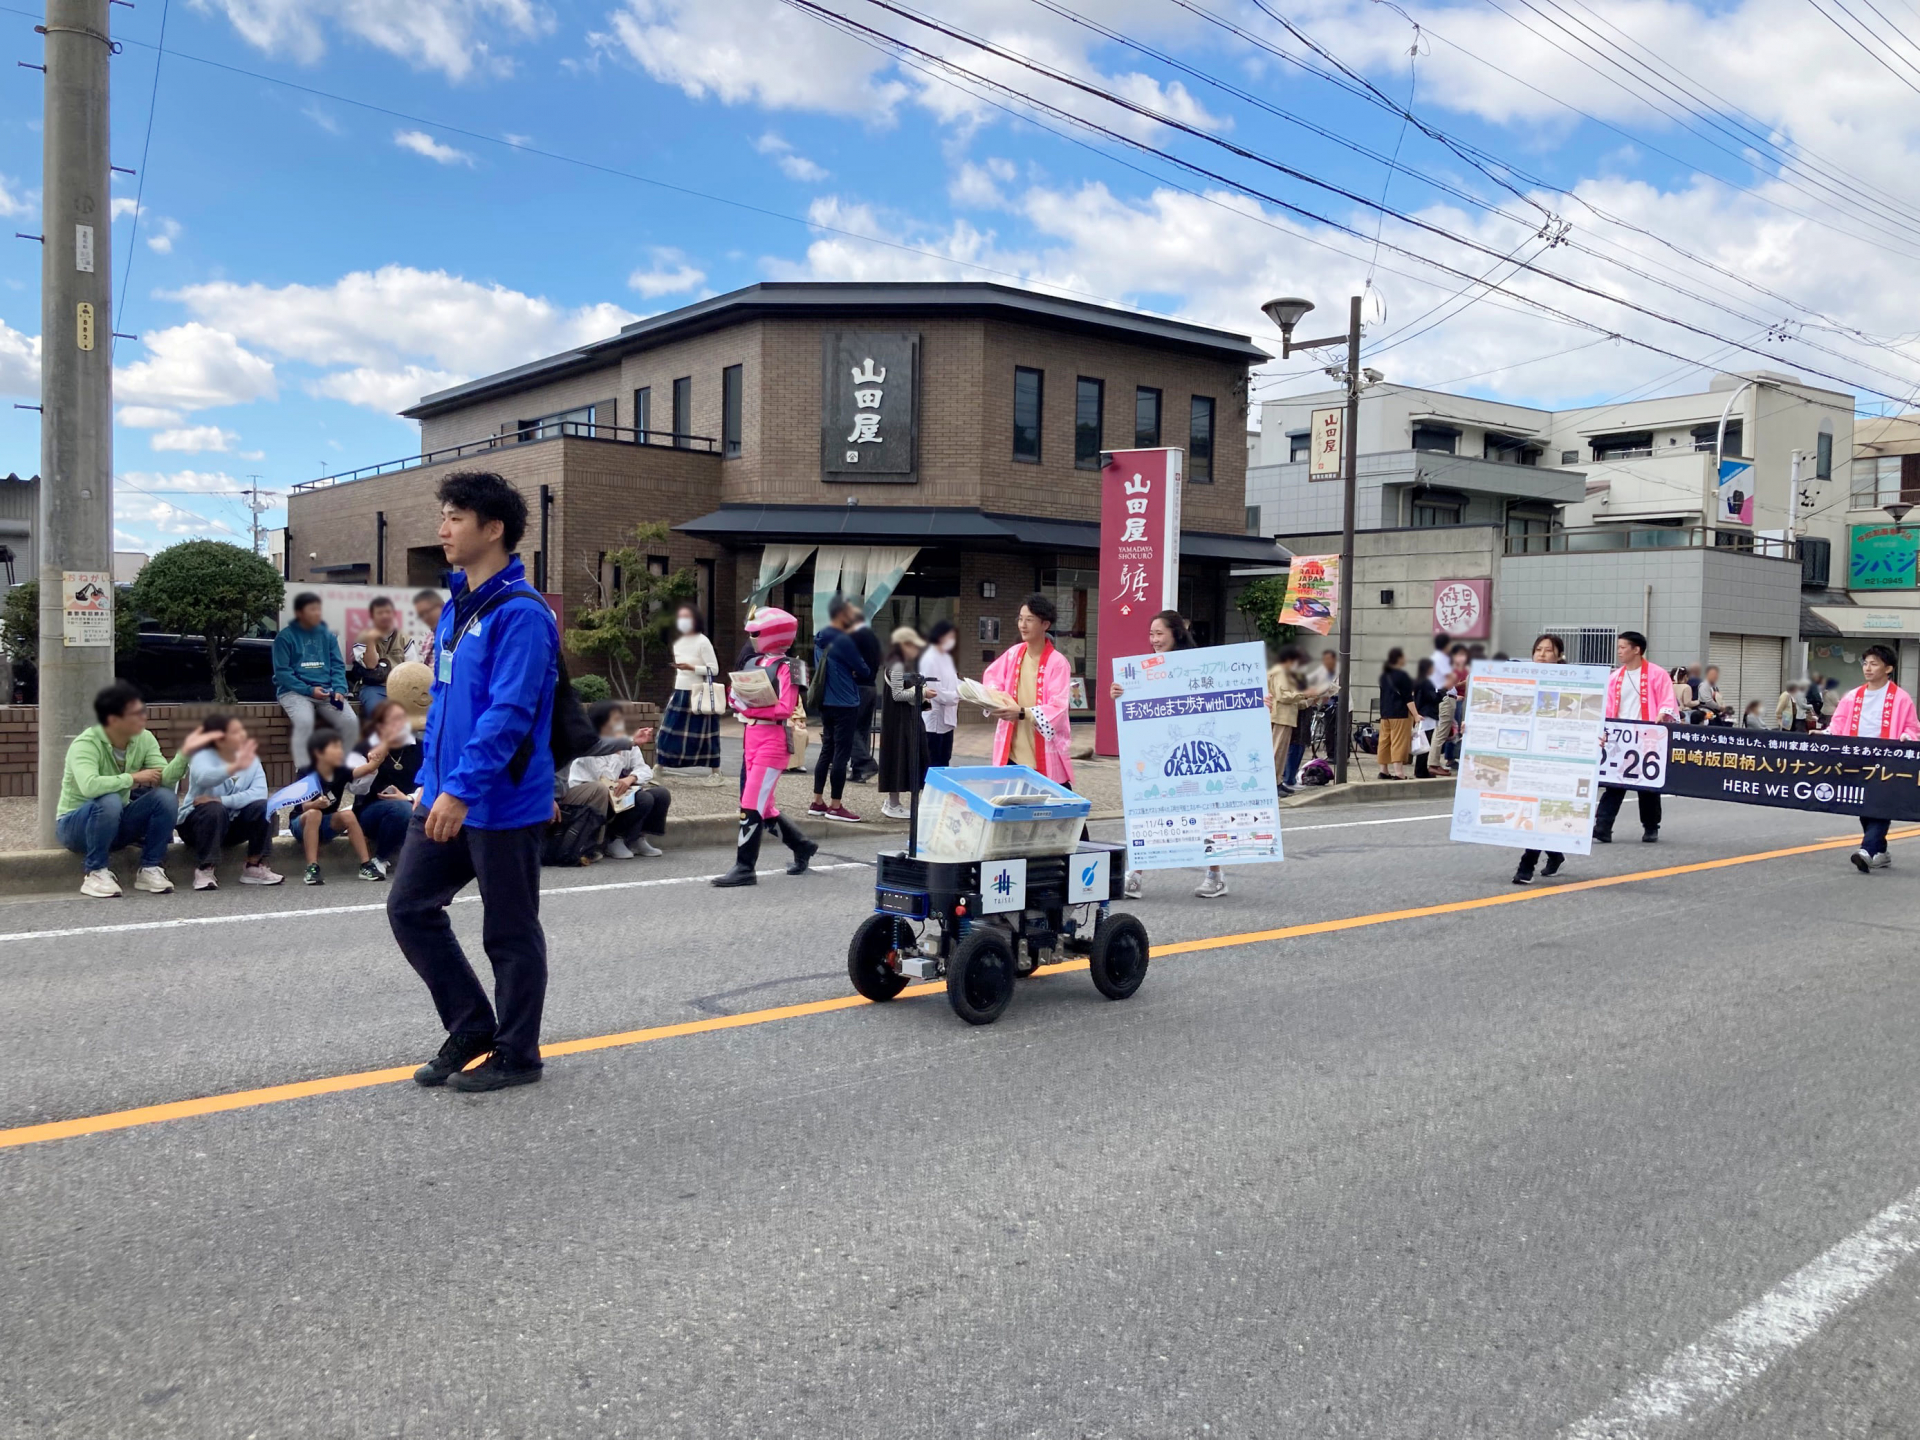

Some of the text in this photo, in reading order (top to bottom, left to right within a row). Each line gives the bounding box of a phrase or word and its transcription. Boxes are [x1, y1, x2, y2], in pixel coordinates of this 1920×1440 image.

[847, 358, 887, 443] 山田屋
[1323, 413, 1339, 454] 山田屋
[1120, 473, 1151, 543] 山田屋
[1118, 552, 1153, 560] SHOKURO
[1298, 575, 1326, 583] JAPAN
[1299, 568, 1325, 576] RALLY
[1502, 666, 1578, 677] 実証内容のご紹介
[1170, 740, 1224, 765] TAISEI
[1164, 753, 1232, 777] OKAZAKI
[1723, 778, 1760, 796] HERE
[1764, 783, 1789, 798] WE
